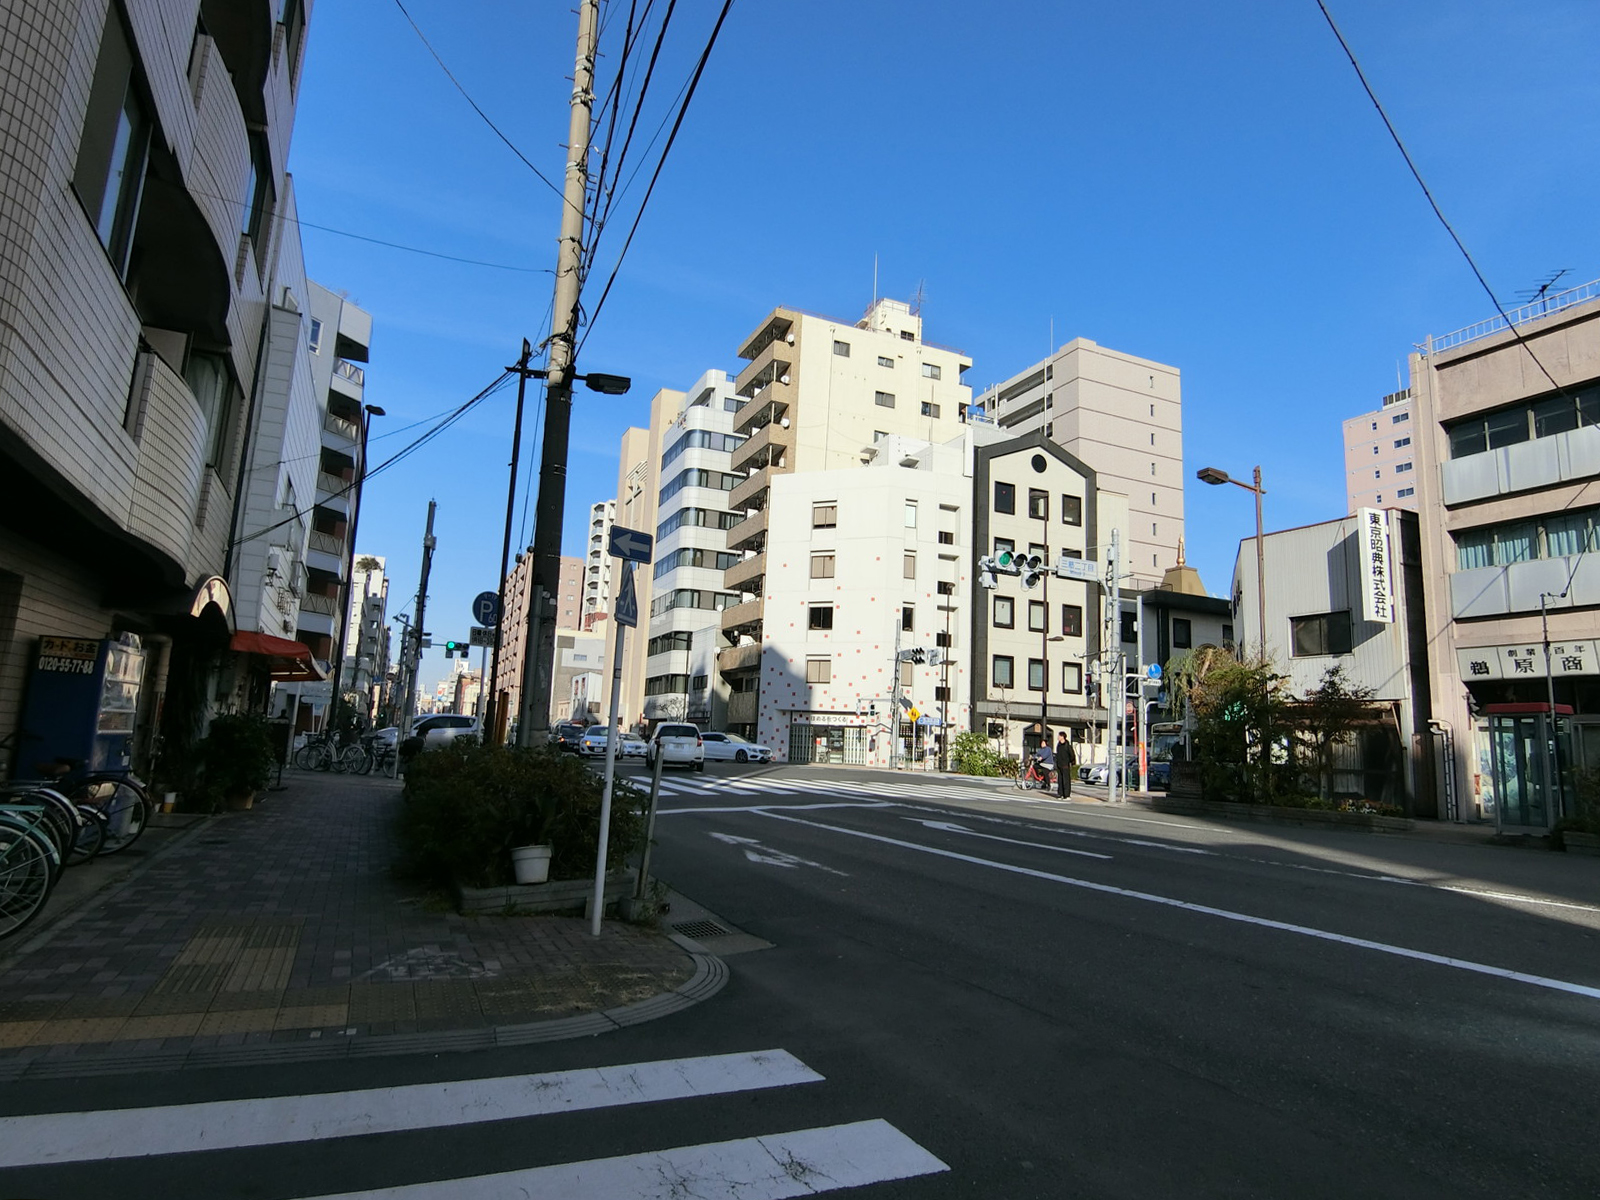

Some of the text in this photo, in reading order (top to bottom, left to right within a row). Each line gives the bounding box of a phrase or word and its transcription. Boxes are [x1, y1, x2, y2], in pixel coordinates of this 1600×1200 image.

[1369, 512, 1388, 618] 東京昭典株式会社
[479, 600, 493, 621] P
